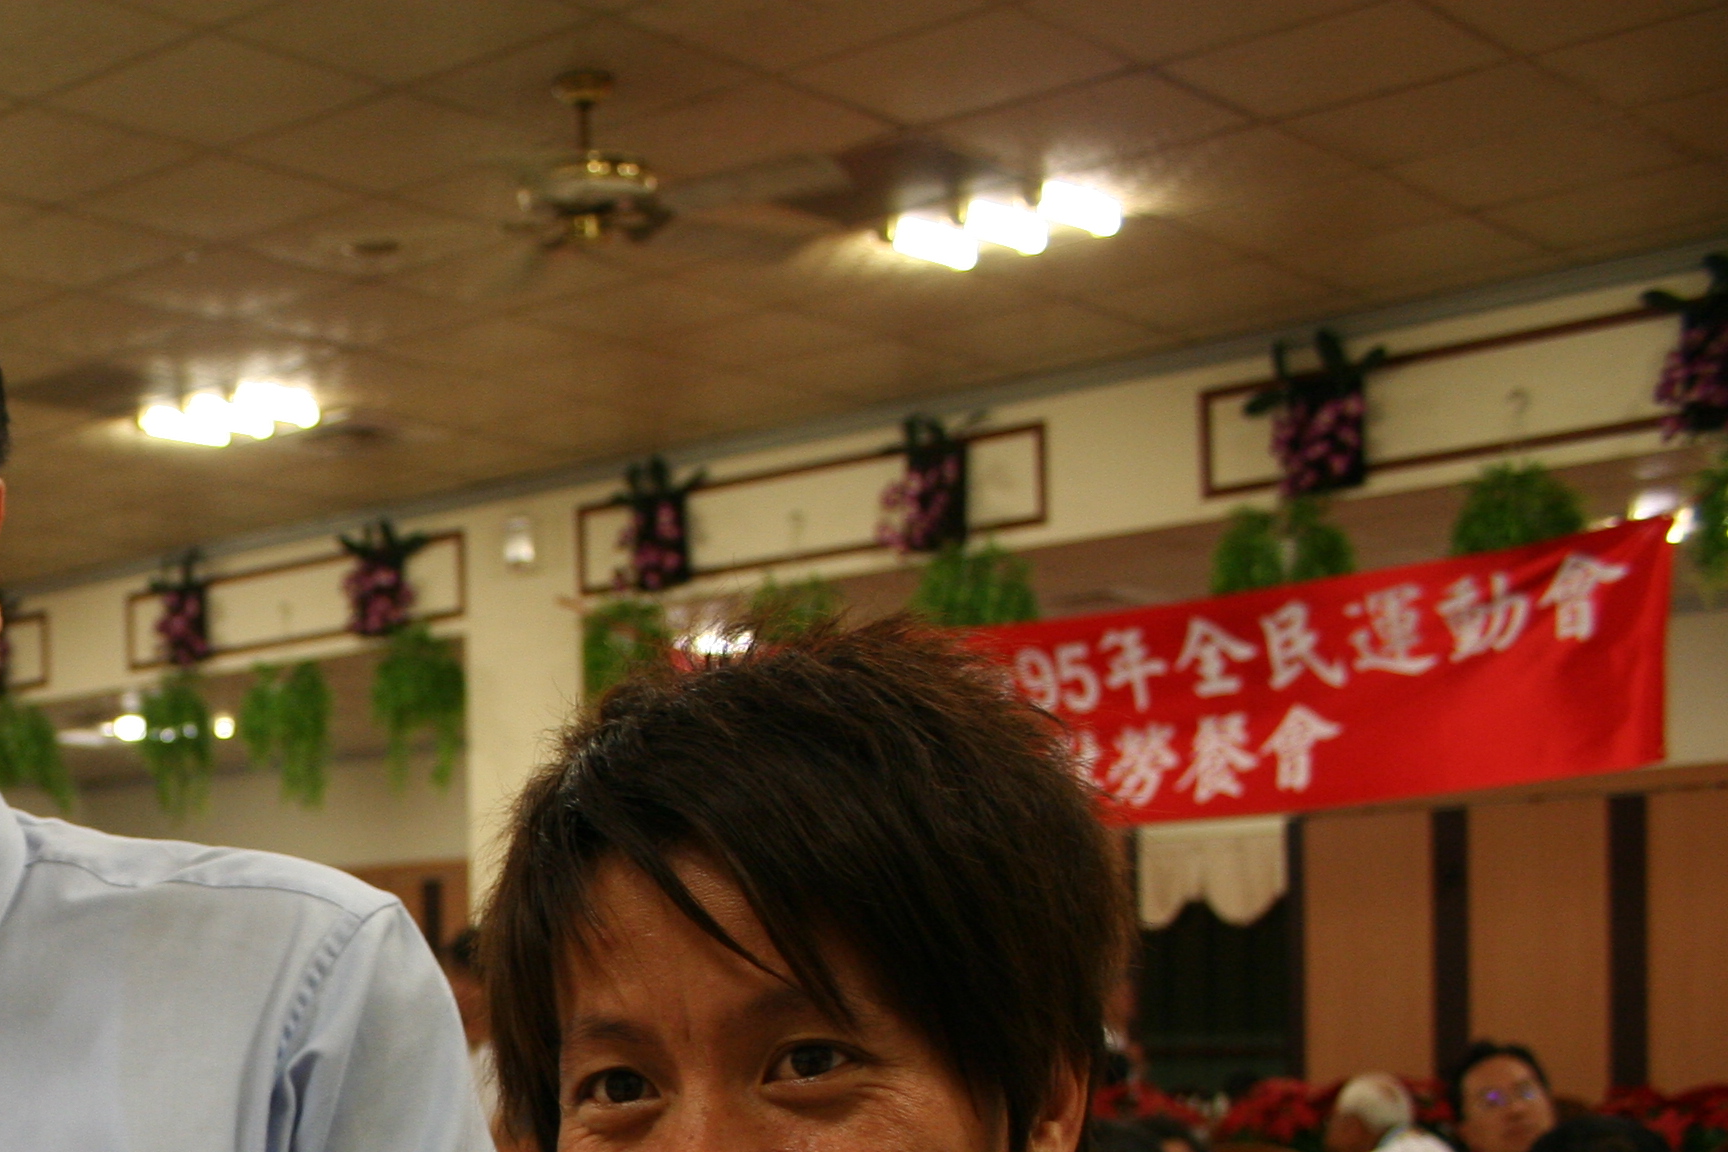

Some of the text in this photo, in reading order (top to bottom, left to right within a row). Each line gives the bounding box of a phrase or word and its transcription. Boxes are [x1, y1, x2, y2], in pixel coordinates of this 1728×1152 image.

[1015, 554, 1629, 714] 95年全民運動會
